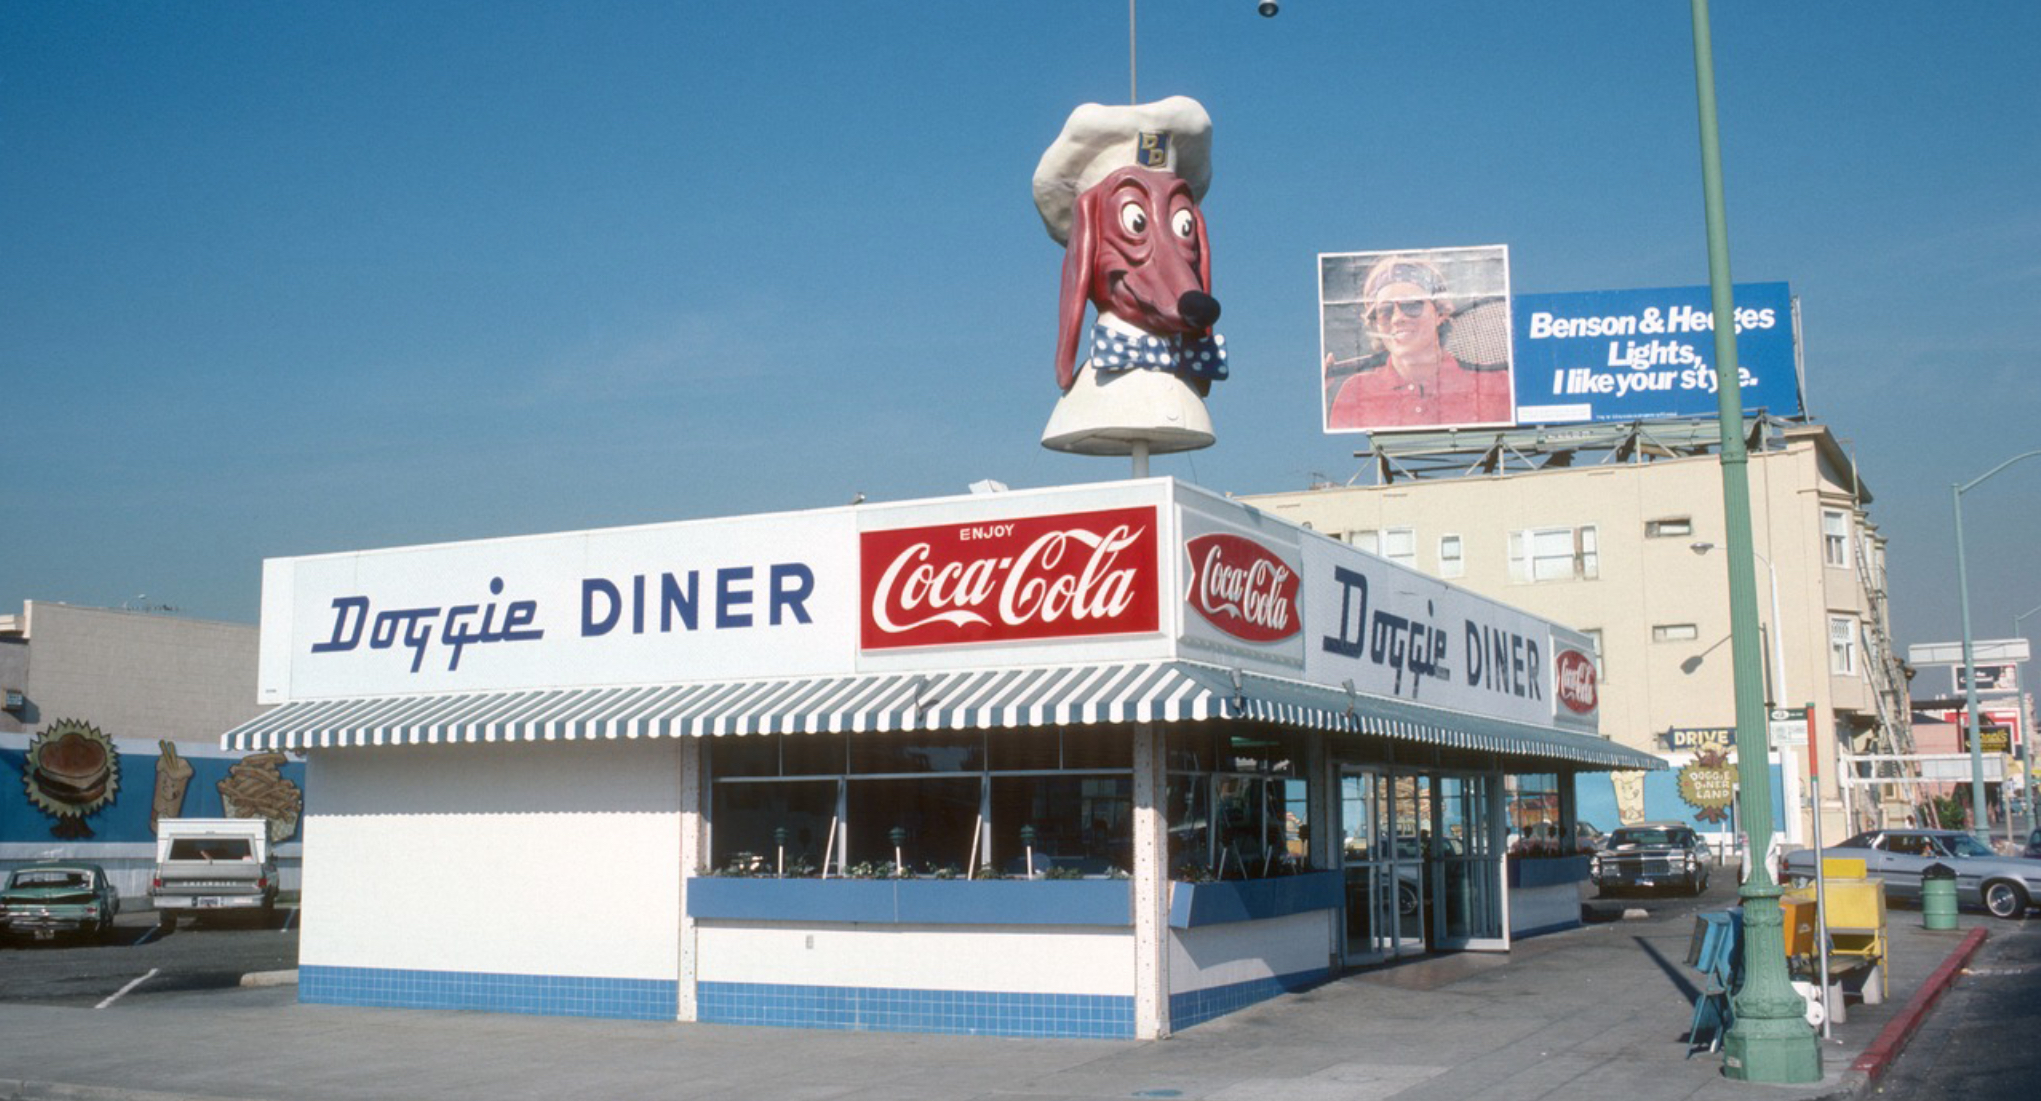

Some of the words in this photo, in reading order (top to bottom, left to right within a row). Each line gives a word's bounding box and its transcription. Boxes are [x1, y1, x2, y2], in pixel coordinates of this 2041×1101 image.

[1529, 312, 1637, 339] Benson
[1638, 306, 1665, 334] &
[1607, 340, 1703, 371] Lights,
[1553, 369, 1563, 394] I
[1567, 368, 1615, 395] like
[1616, 371, 1678, 398] your
[1680, 364, 1759, 394] stye.
[959, 524, 1015, 541] ENJOY
[872, 525, 1147, 634] Coca-Cola
[1200, 544, 1290, 630] Coca-Cola
[311, 577, 545, 673] Doggie
[581, 562, 816, 637] DINER
[1323, 565, 1450, 699] Doggie
[1465, 619, 1541, 700] DINER
[1674, 730, 1729, 745] DRIVE
[1696, 789, 1729, 799] LAND
